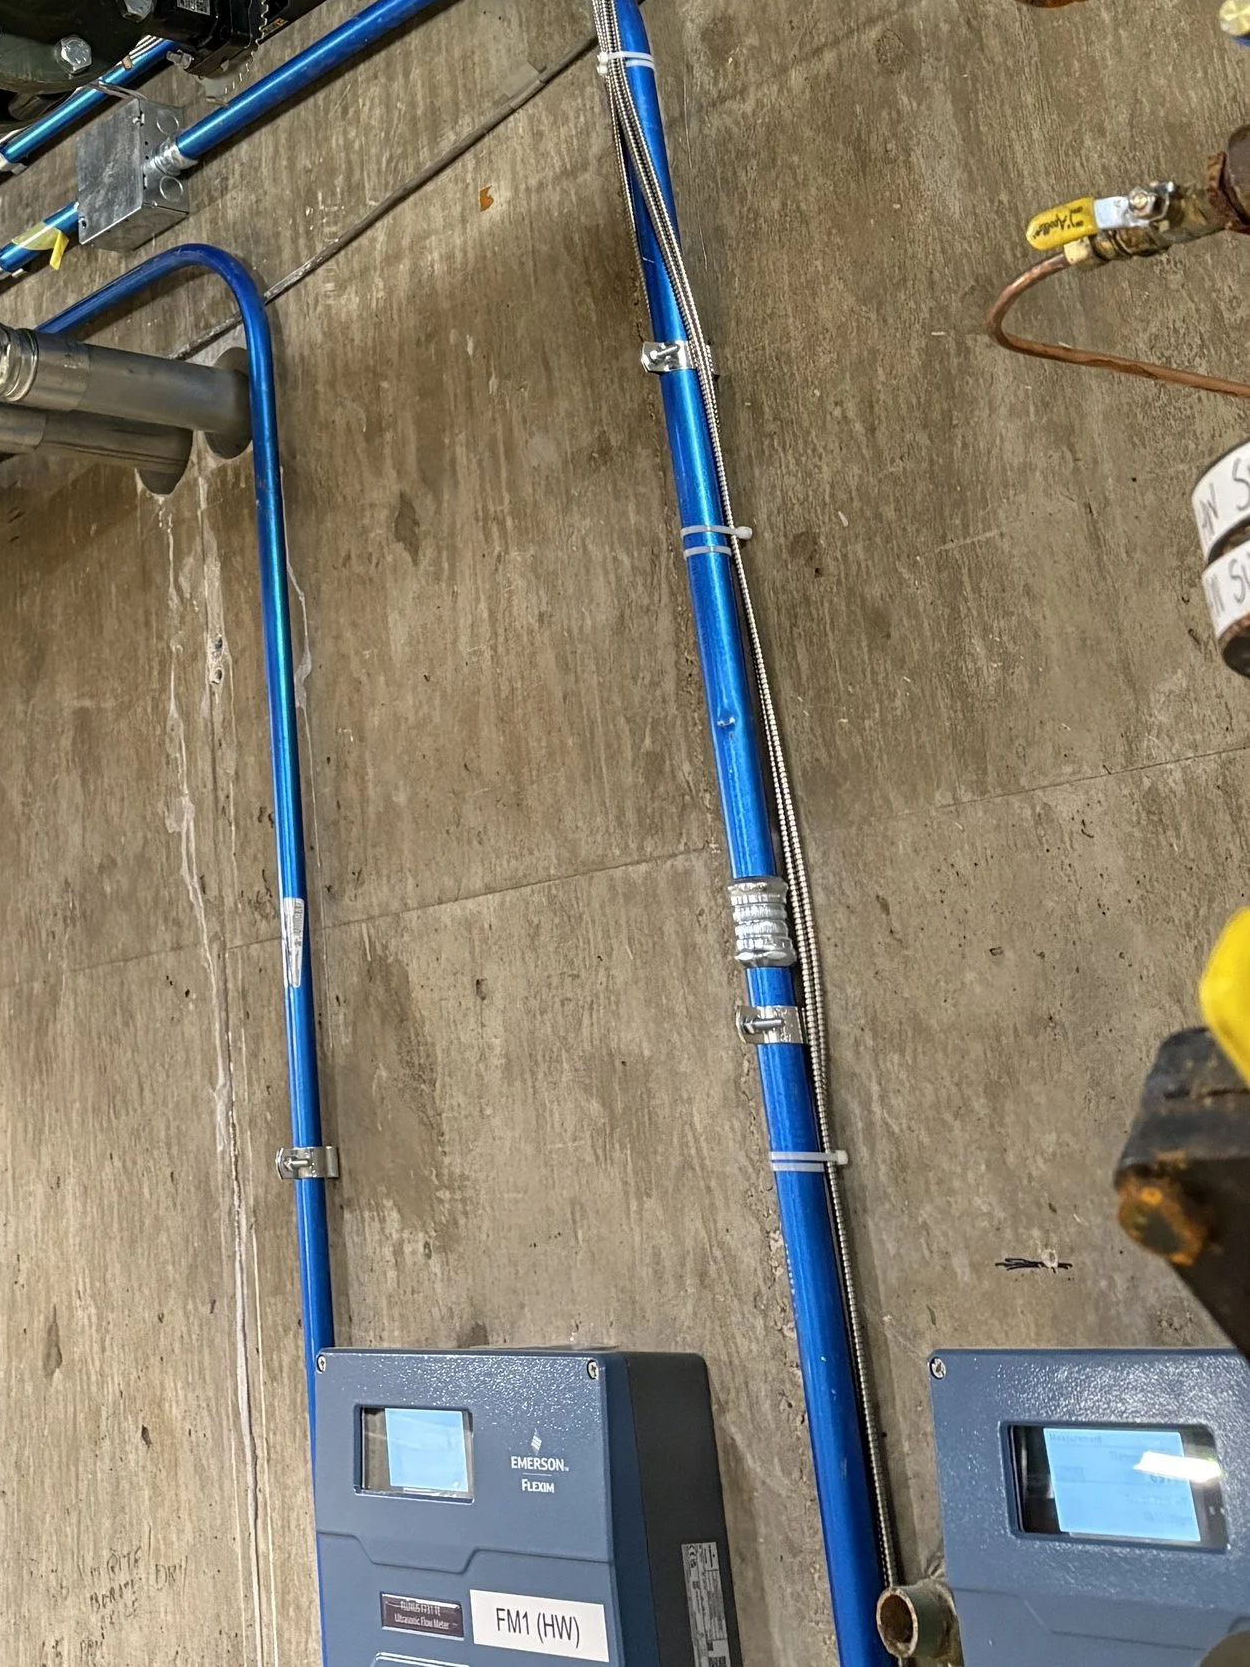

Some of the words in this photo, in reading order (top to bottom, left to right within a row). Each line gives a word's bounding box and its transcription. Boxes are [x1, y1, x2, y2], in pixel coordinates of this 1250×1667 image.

[510, 1455, 565, 1471] EMERSON
[521, 1478, 555, 1493] FLEXIM
[394, 1612, 420, 1625] Ultrasonic
[420, 1615, 433, 1627] Flow
[433, 1617, 450, 1630] Meter
[496, 1607, 530, 1635] FM1
[537, 1612, 581, 1649] (HW)
